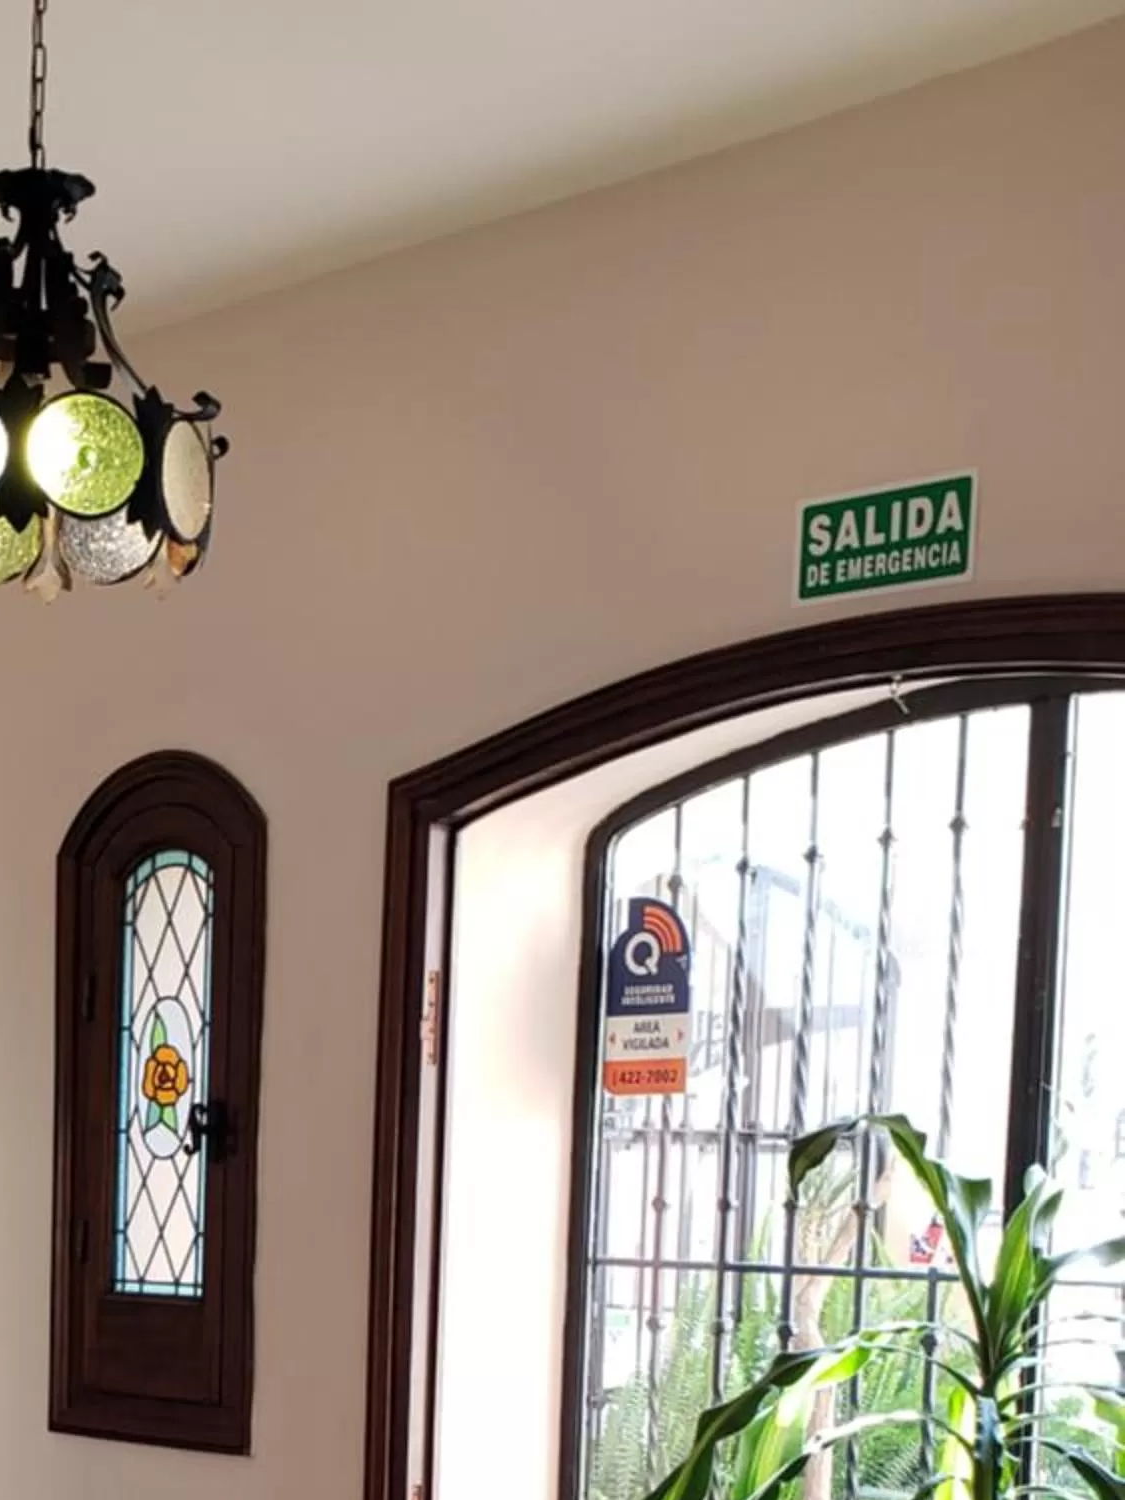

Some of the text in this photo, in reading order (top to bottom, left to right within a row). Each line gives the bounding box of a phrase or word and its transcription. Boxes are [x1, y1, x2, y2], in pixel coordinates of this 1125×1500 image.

[808, 491, 963, 557] SALIDA
[806, 540, 961, 588] DE EMERGENCIA
[625, 932, 660, 976] Q
[622, 1037, 669, 1050] VIGILADA
